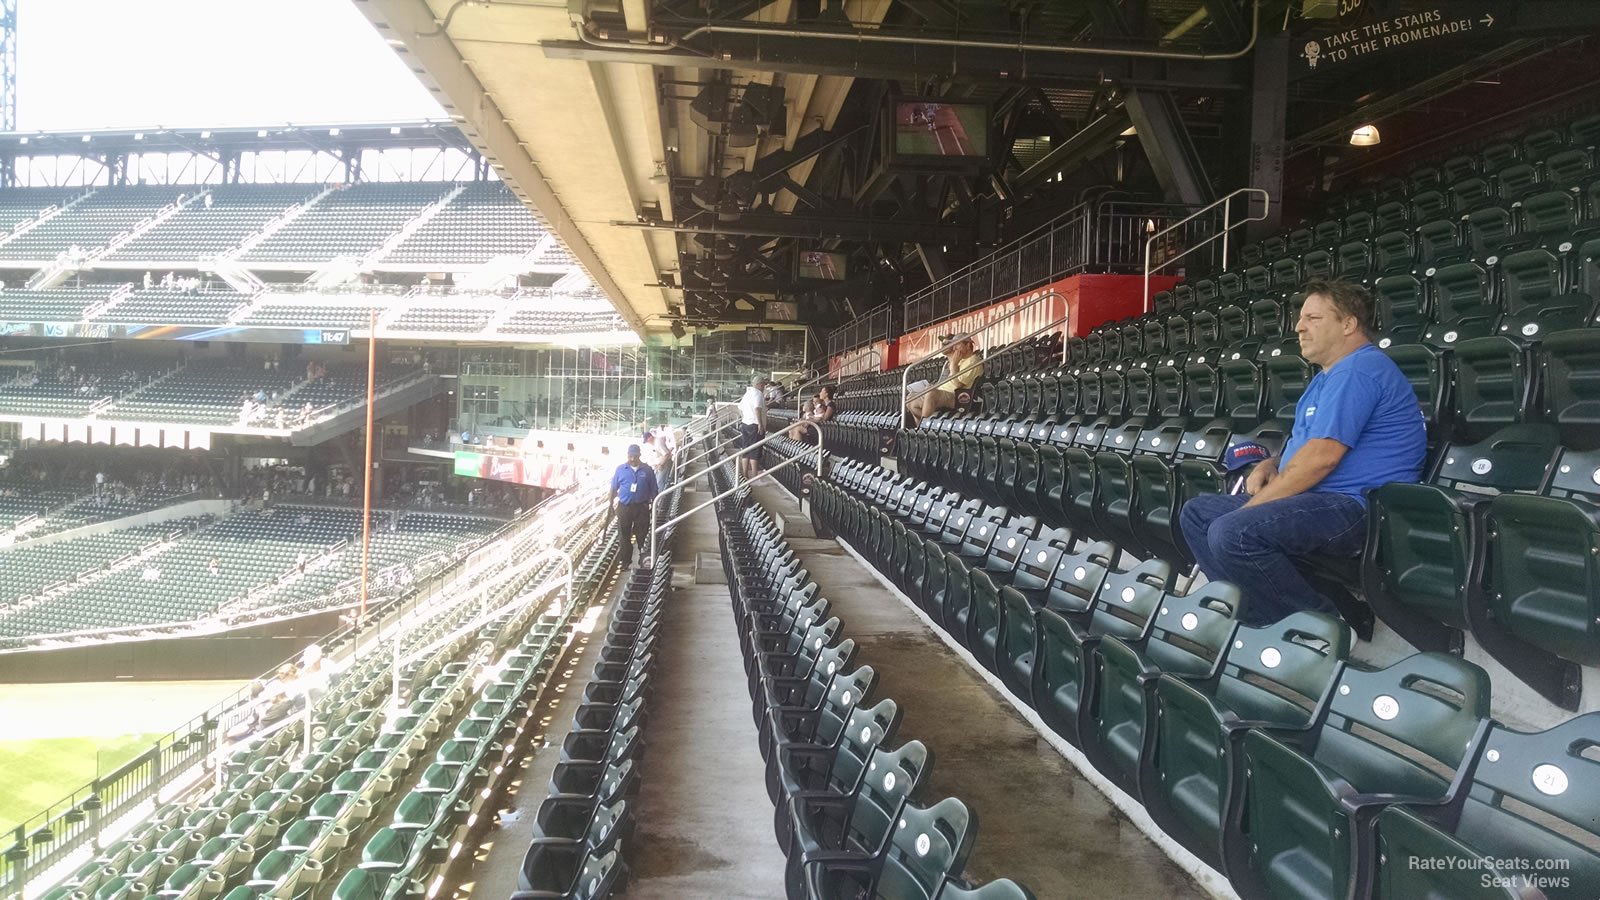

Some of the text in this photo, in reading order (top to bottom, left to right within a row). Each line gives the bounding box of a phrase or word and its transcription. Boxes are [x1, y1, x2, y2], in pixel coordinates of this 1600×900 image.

[1324, 10, 1441, 48] TAKE THE STAIRS
[1328, 19, 1472, 63] TO THE PROMENADE!
[46, 325, 64, 335] VS
[322, 332, 345, 342] 11:47
[988, 302, 1015, 349] FOR
[1020, 288, 1054, 342] YOU
